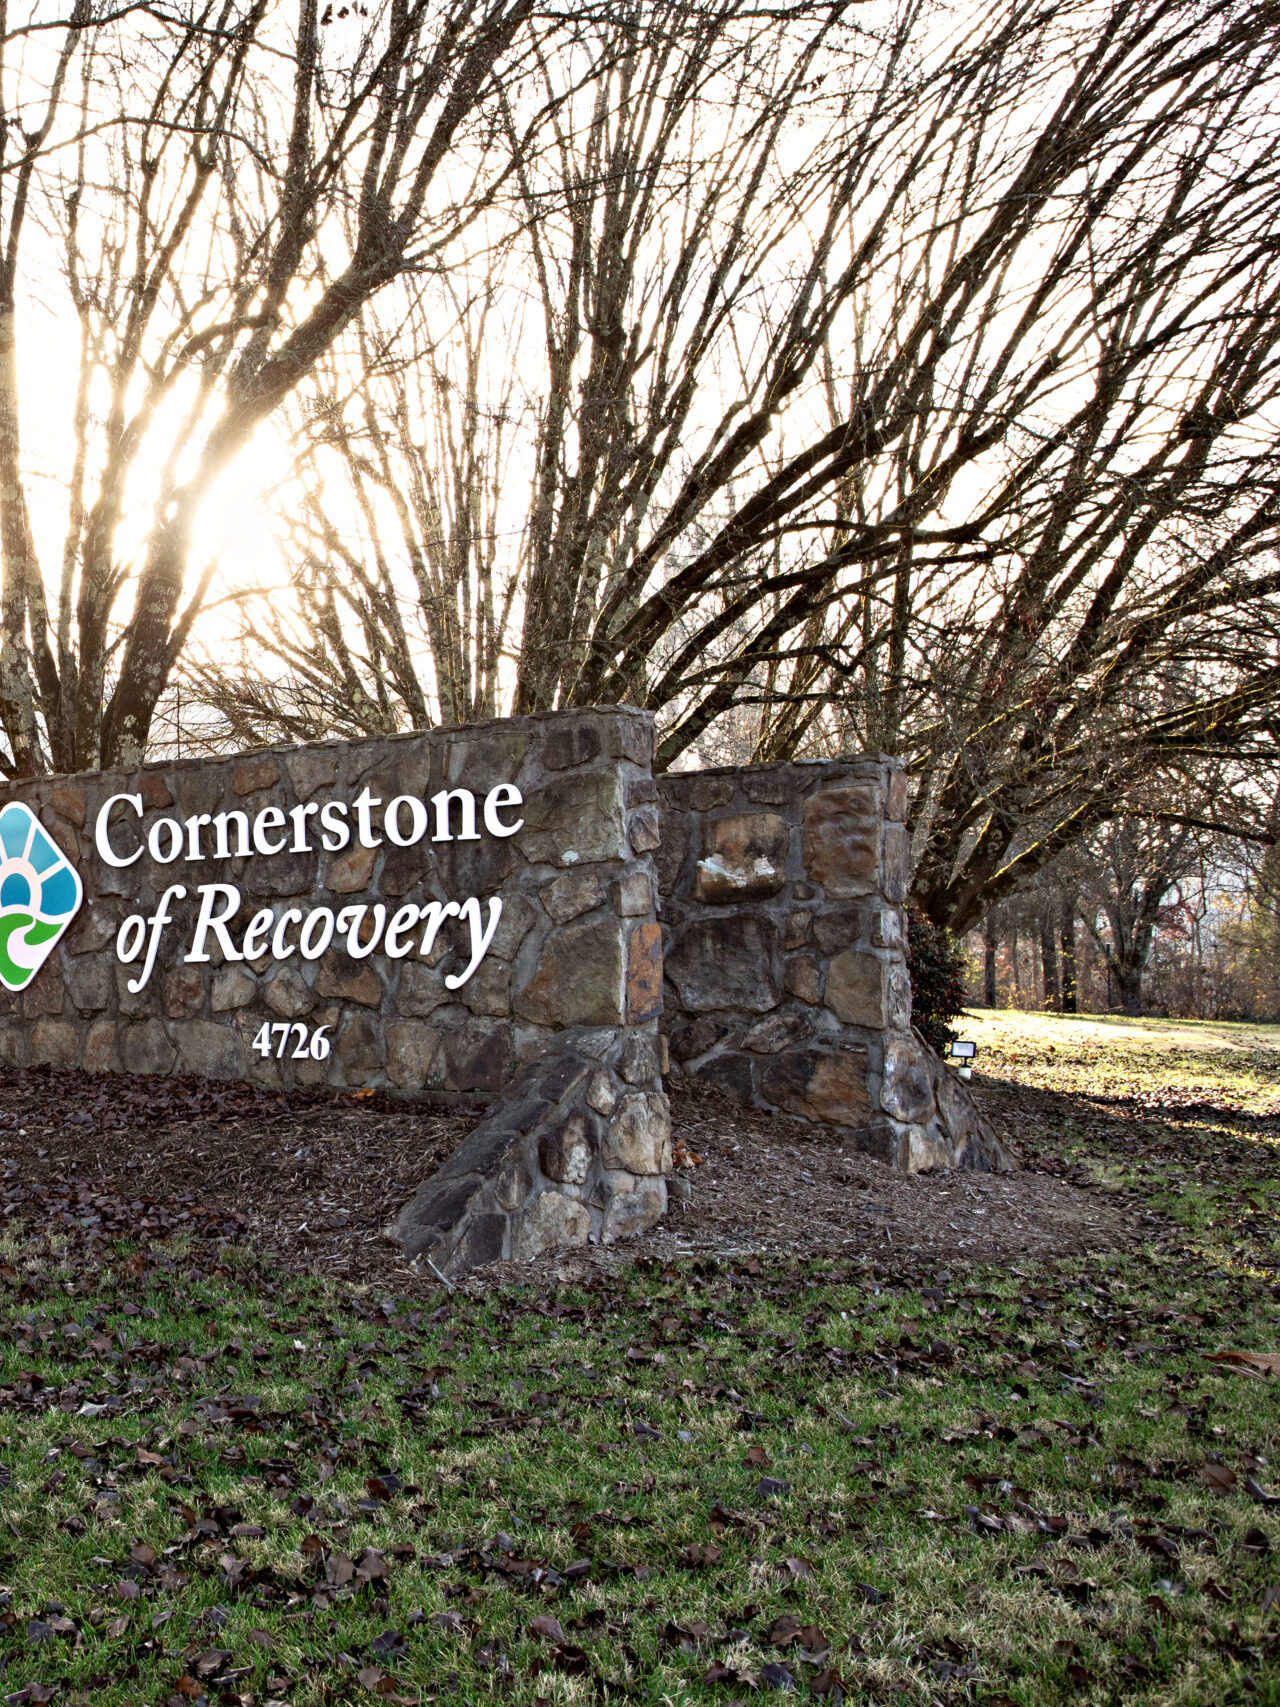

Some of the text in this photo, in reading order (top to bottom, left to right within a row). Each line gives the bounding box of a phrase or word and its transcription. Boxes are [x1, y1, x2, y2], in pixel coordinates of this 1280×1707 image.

[95, 783, 525, 868] Cornerstone
[116, 883, 503, 994] of Recovery
[252, 1021, 331, 1061] 4726
